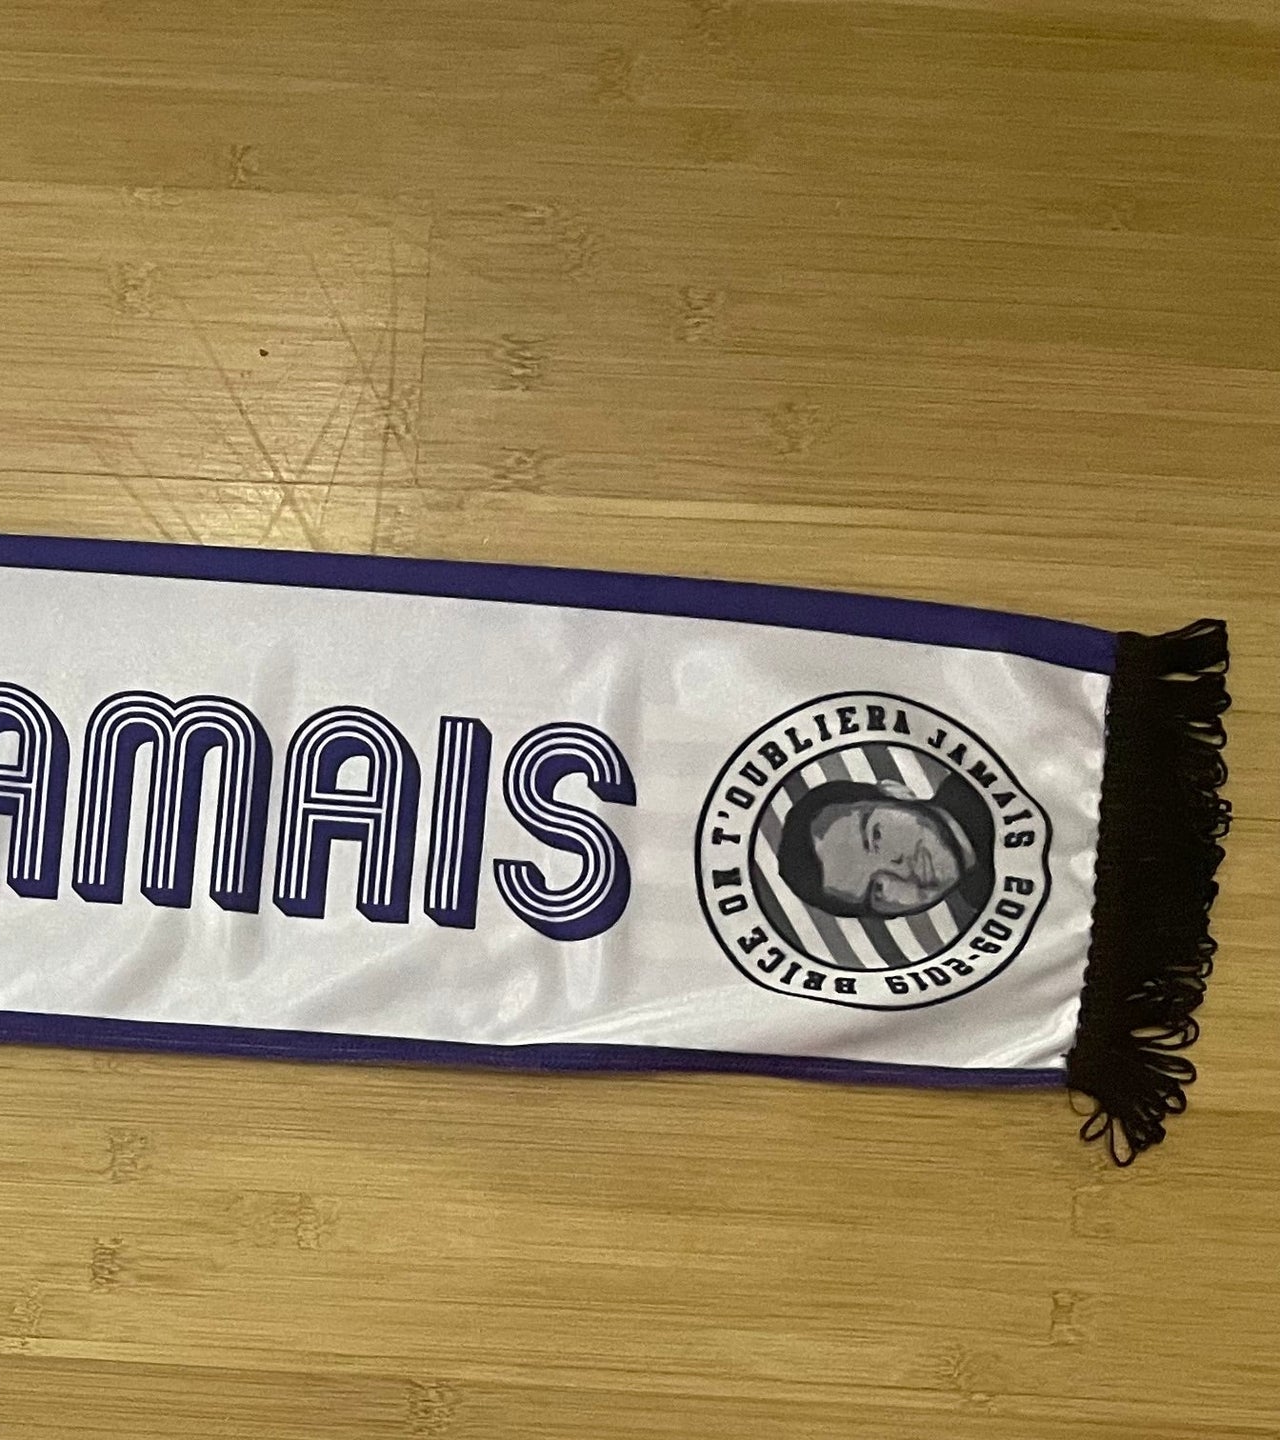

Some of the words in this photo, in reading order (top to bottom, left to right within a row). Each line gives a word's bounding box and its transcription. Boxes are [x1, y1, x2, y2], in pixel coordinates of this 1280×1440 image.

[711, 704, 910, 846] T'OUBLIERA
[928, 728, 1035, 849] JAMAIS
[712, 867, 748, 916] ON
[885, 875, 1034, 995] 2009-2019
[737, 926, 857, 995] BRICE
